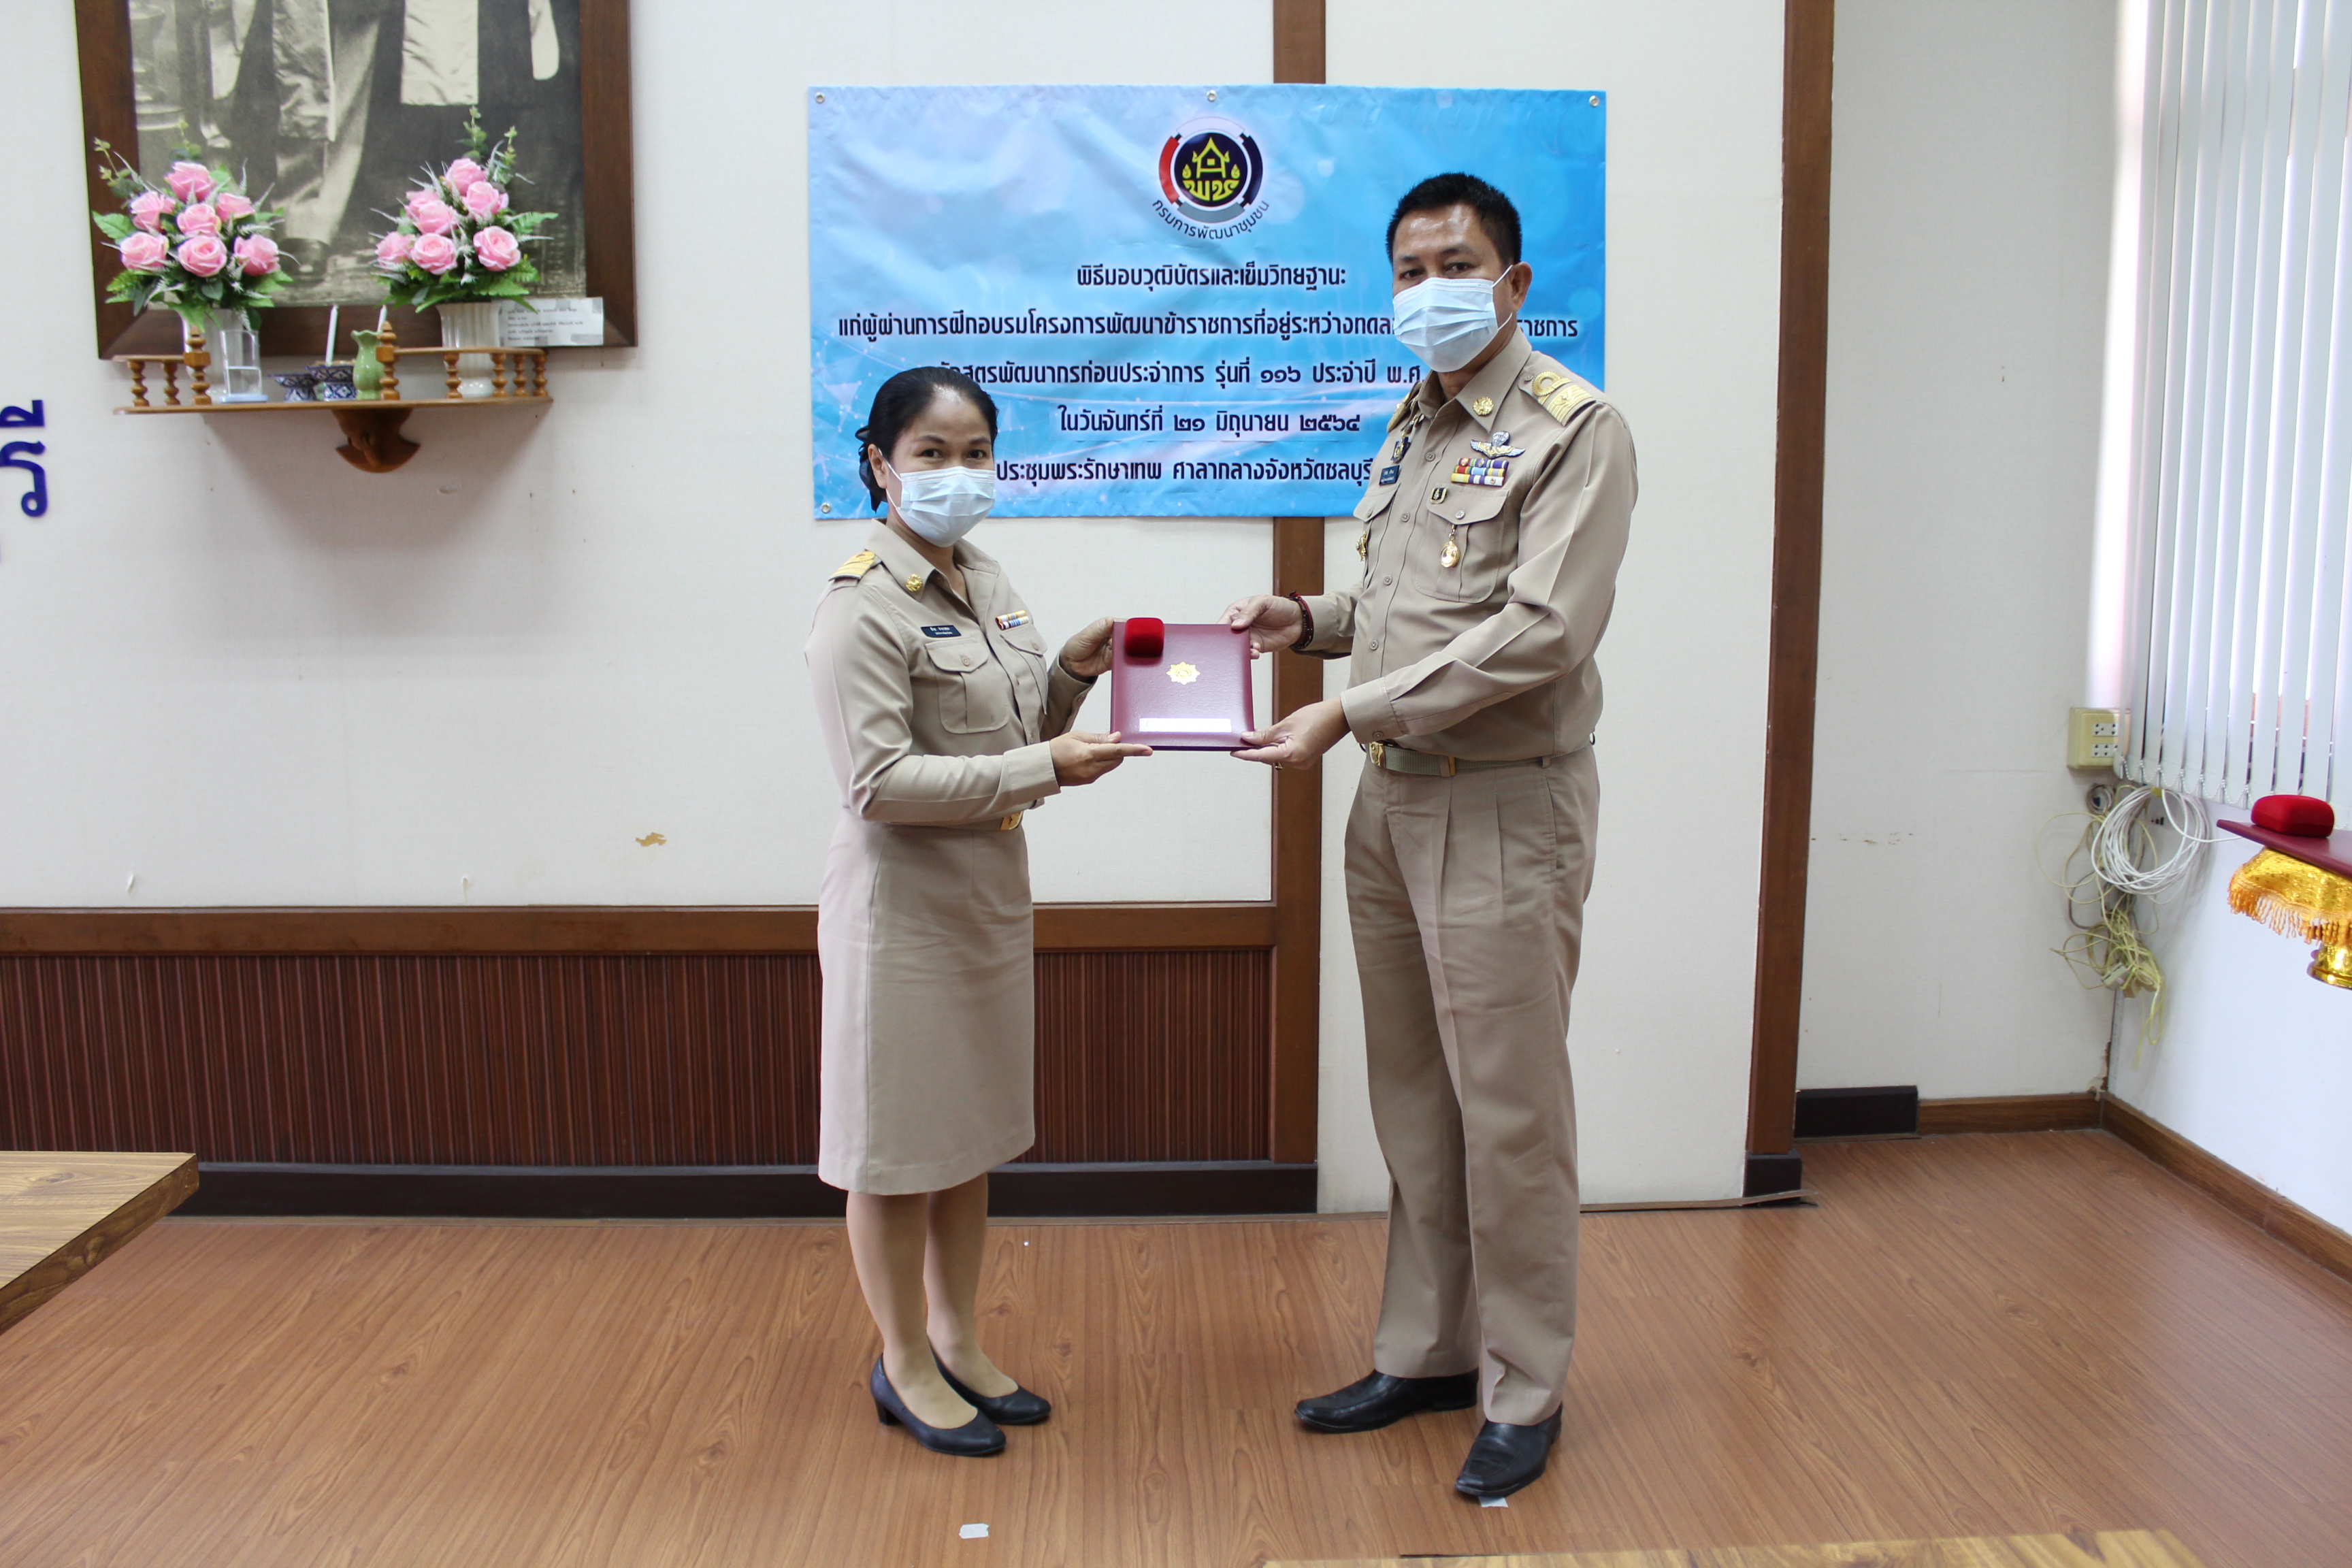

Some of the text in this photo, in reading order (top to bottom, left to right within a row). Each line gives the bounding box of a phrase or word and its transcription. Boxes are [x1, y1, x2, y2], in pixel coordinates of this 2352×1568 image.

[1152, 200, 1270, 240] กรมการพัฒนาชุมชน
[1077, 261, 1346, 292] พิธีมอบวุฒิบัตรและเข็มวิทยฐานะ
[838, 308, 1395, 342] แก่ผู้ผ่านการฝึกอบรมโครงการพัฒนาข้าราชการที่อยู่ระหว่างทดล
[1215, 357, 1250, 389] รุ่นที่
[1260, 365, 1301, 383] ๑๑๖
[1313, 358, 1376, 383] ประจำปี
[1057, 404, 1360, 438] ในวันจันทร์ที่ ๒๑ มิถุนายน ๒๕๖๔
[996, 457, 1162, 487] ประชุมพระรักษาเทพ
